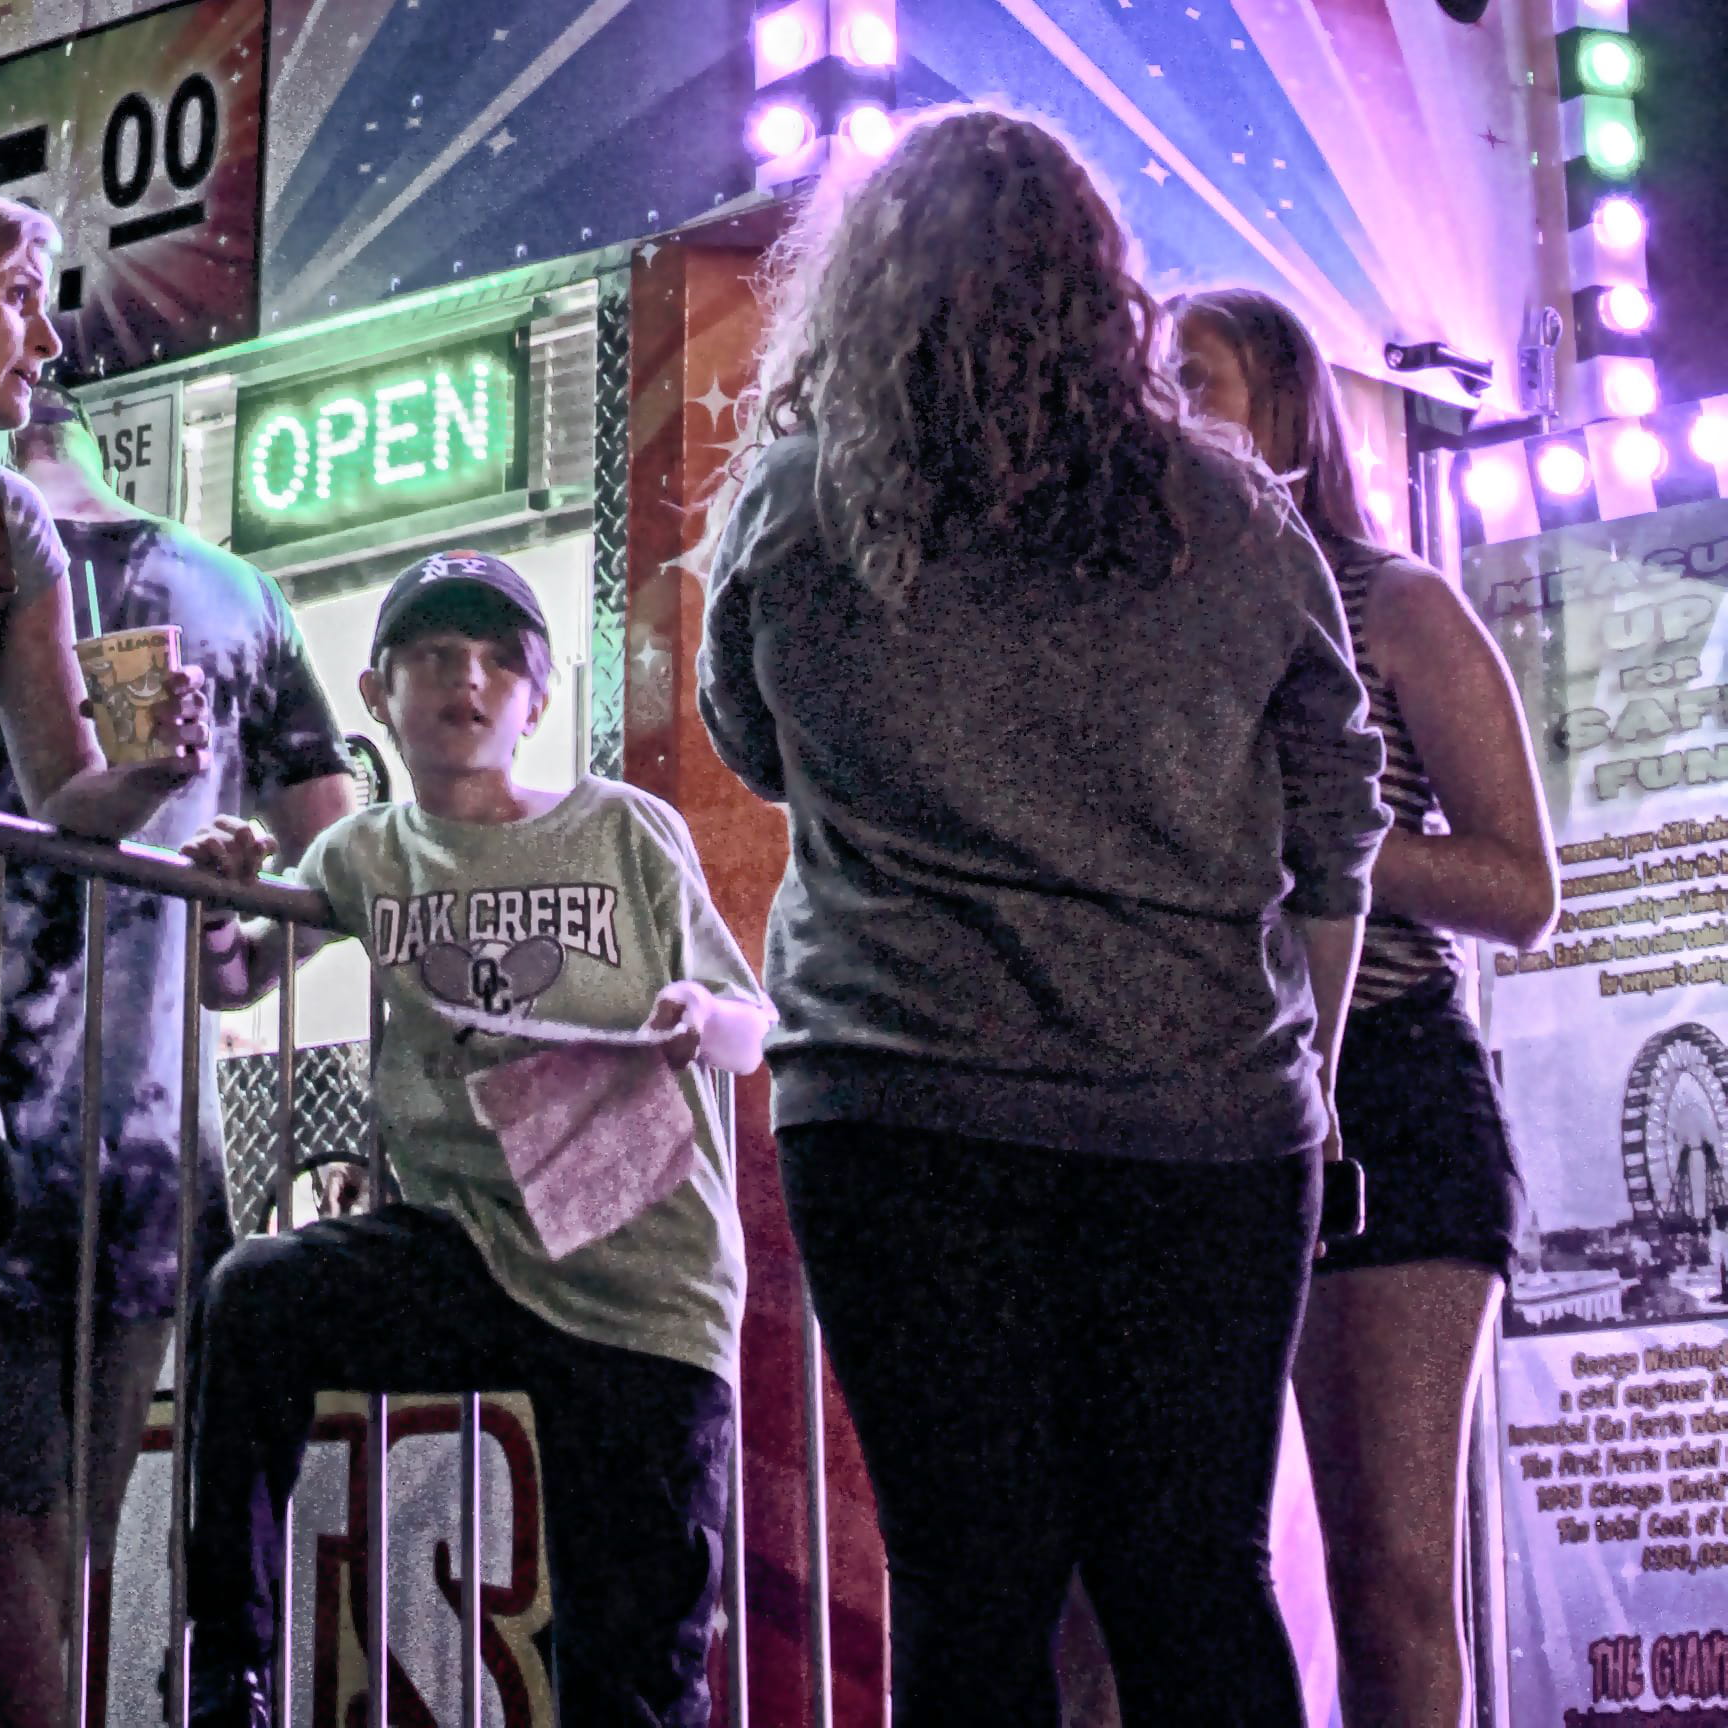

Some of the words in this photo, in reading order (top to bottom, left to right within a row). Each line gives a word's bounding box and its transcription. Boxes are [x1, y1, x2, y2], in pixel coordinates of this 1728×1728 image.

[252, 363, 489, 510] OPEN
[1603, 594, 1712, 652] UP
[372, 890, 458, 967] OAK
[468, 882, 621, 968] CREEK
[1589, 1635, 1645, 1703] THE
